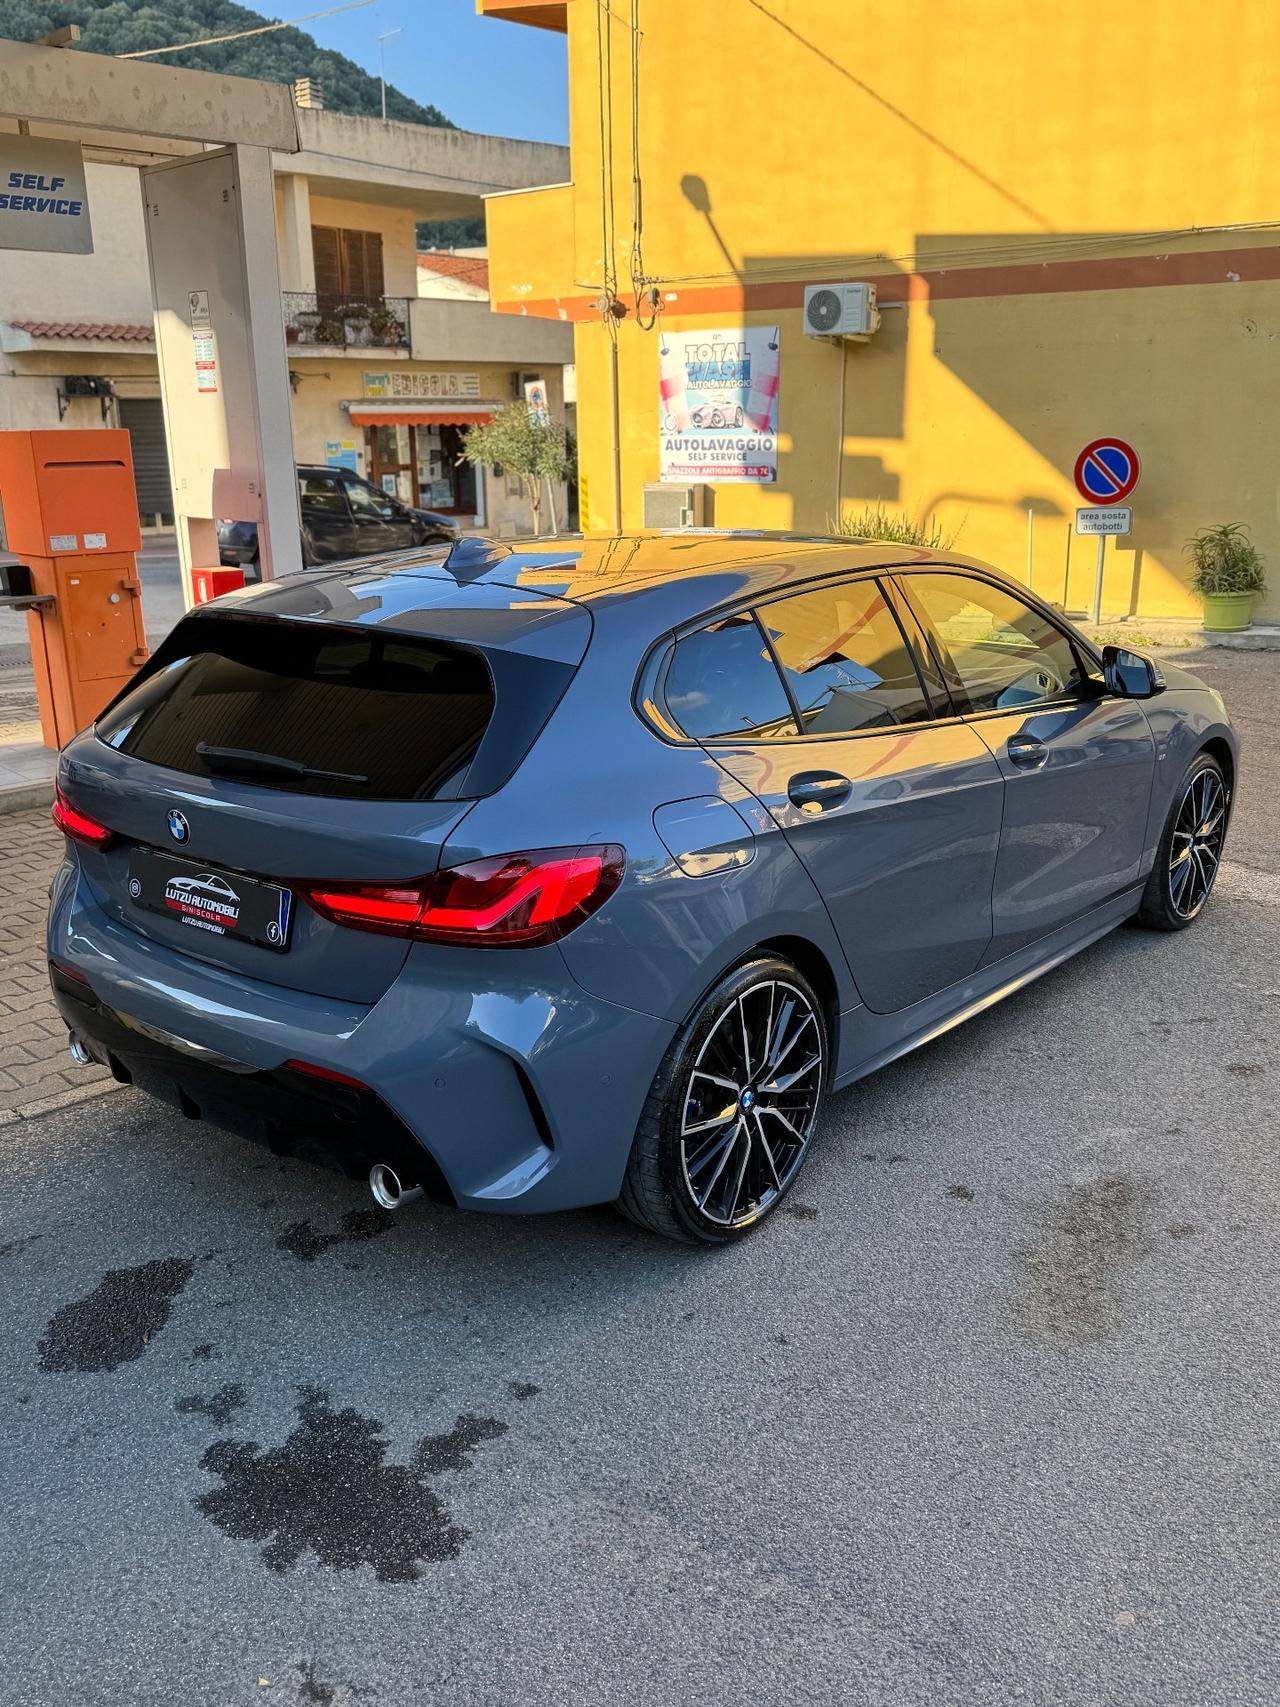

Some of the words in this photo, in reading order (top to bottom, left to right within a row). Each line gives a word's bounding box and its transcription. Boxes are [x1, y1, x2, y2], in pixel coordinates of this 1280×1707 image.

[8, 172, 65, 191] SELF
[0, 193, 82, 216] SERVICE
[685, 342, 751, 363] TOTAL
[687, 360, 751, 381] WASH
[687, 379, 753, 390] AUTOLAVAGGIO
[665, 438, 773, 451] AUTOLAVAGGIO
[688, 452, 708, 461] SELF
[710, 452, 747, 461] SERVICE
[747, 466, 758, 475] DA
[1101, 512, 1126, 520] sosta
[1083, 522, 1123, 531] autobotti
[165, 887, 193, 906] LUTZU
[181, 904, 221, 922] SINISCOLA
